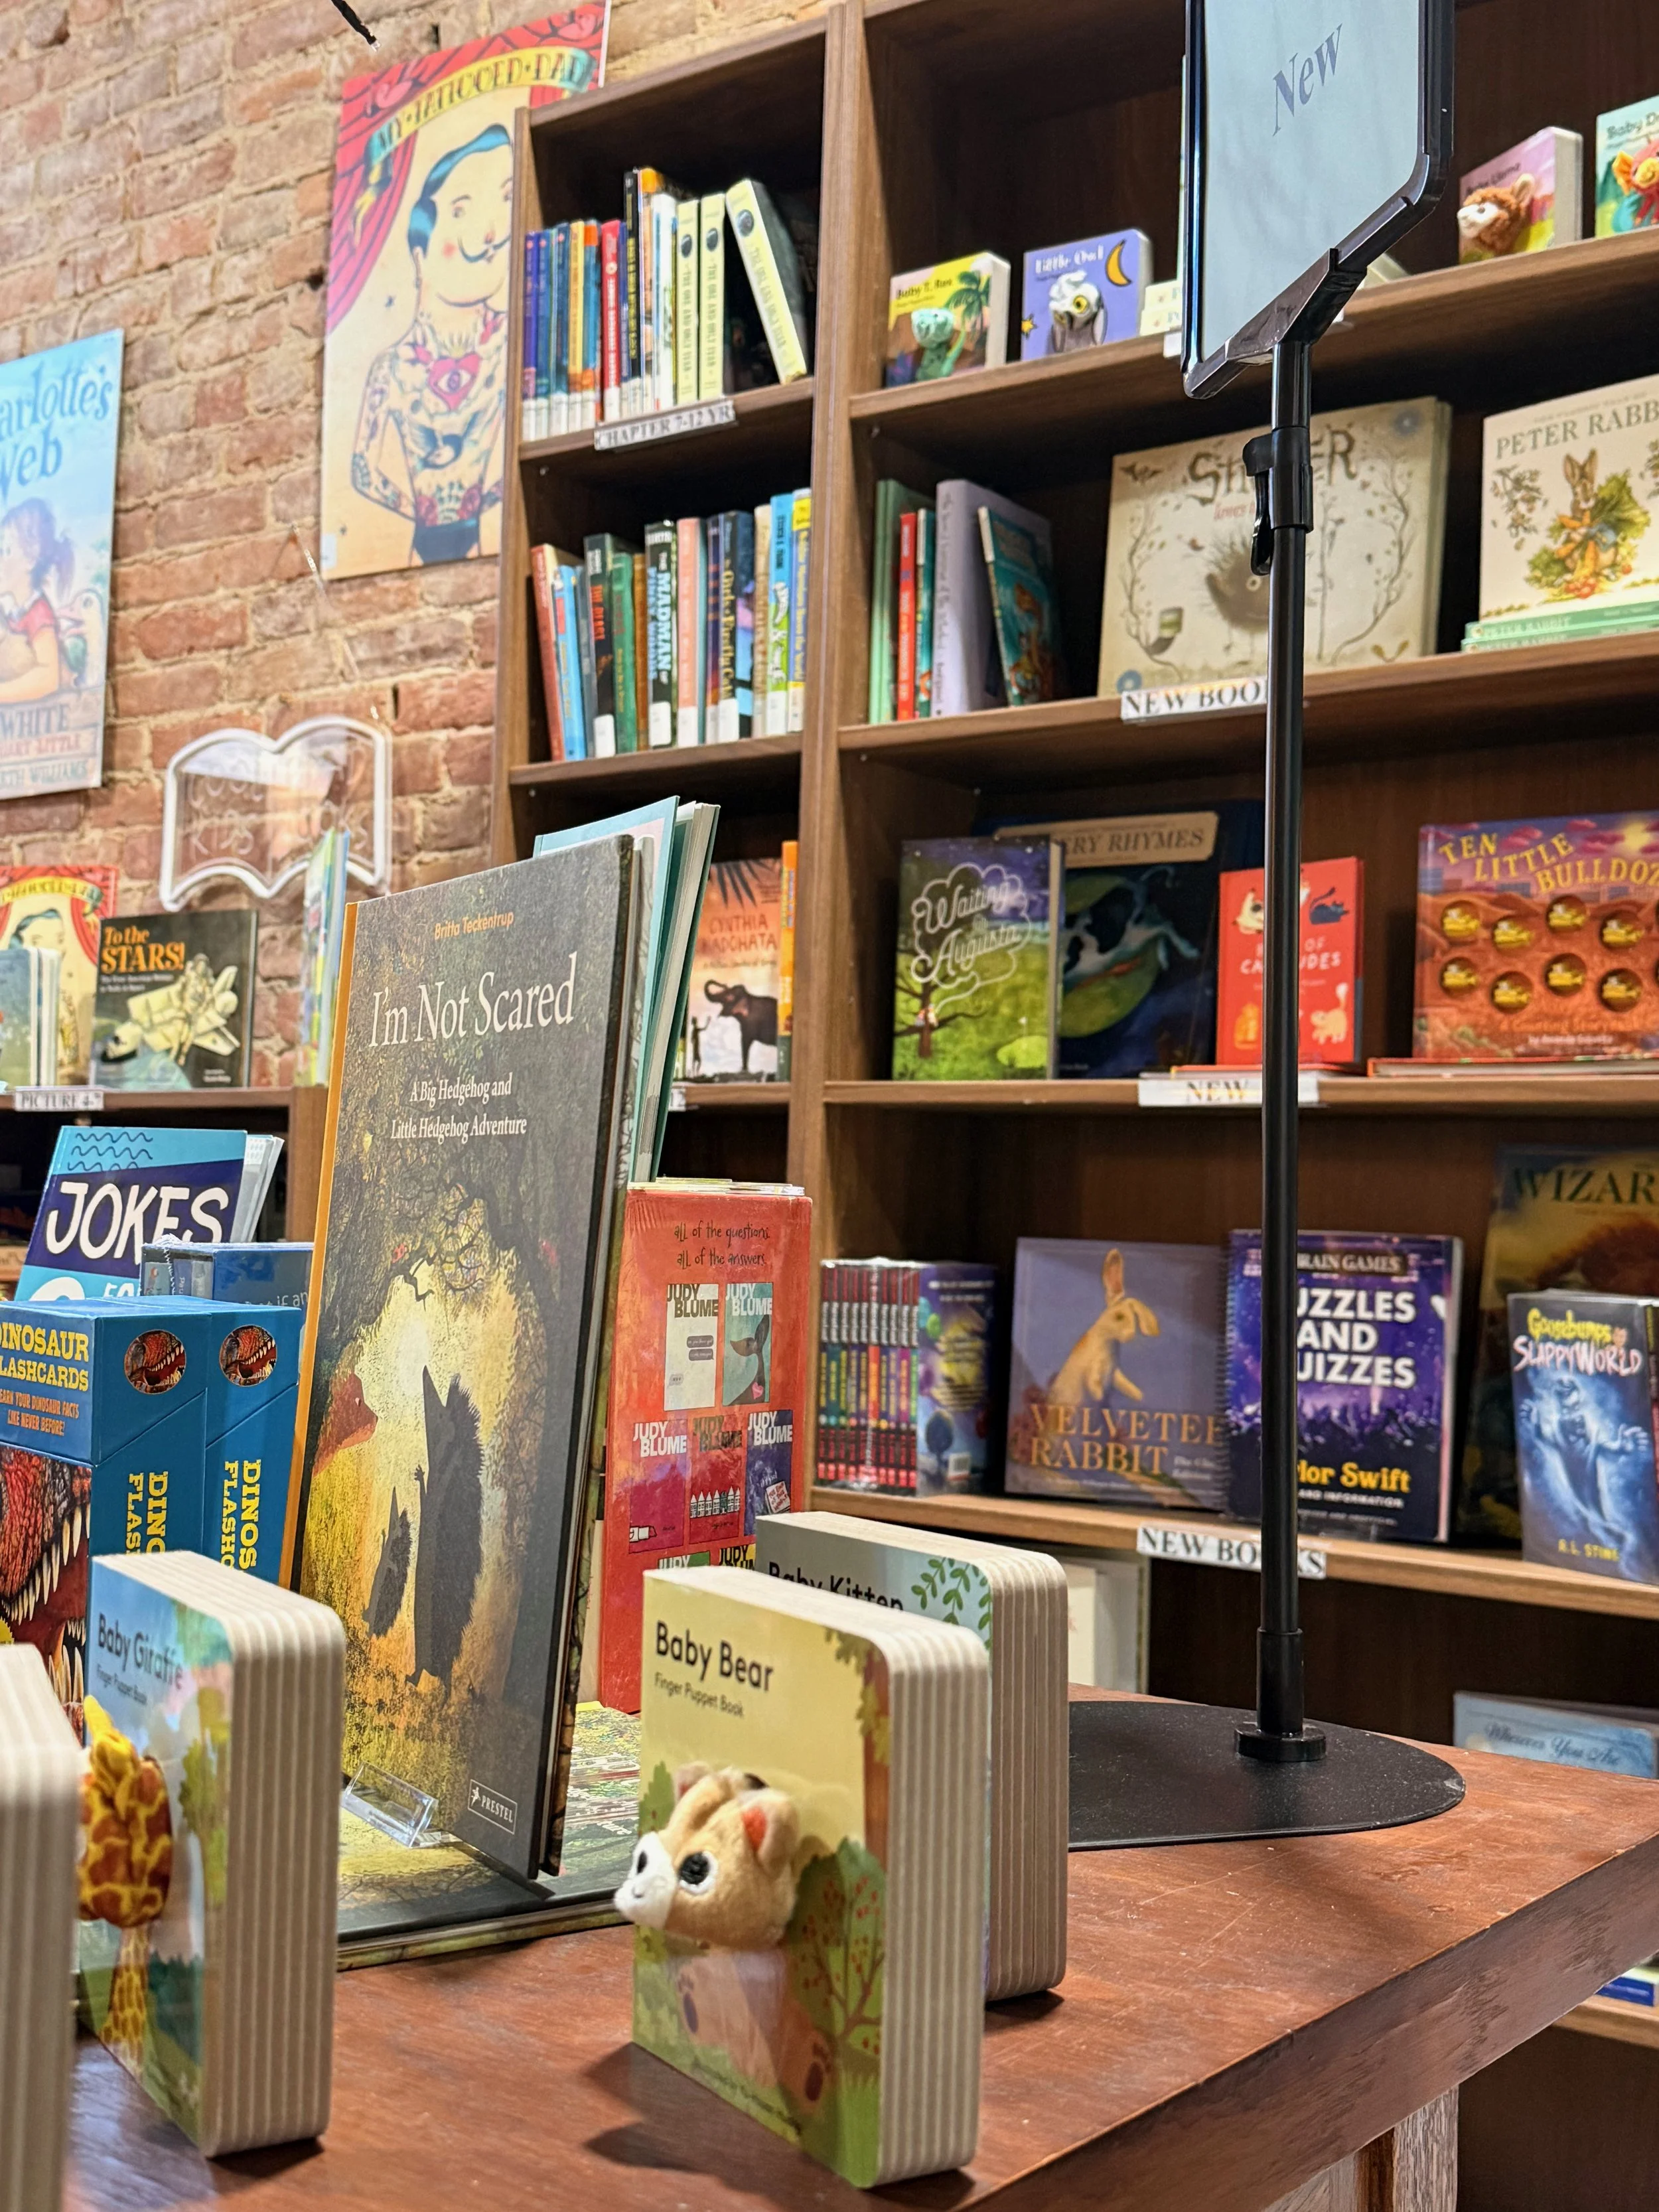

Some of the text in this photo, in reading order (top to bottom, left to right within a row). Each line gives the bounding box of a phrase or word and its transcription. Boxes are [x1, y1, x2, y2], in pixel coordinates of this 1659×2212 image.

[1272, 23, 1343, 136] New
[0, 362, 113, 438] arlotte's
[1496, 419, 1579, 460] PETER
[1588, 400, 1659, 437] RABB
[656, 573, 672, 671] MADMAN
[1127, 681, 1263, 714] NEW BOO
[1108, 829, 1204, 852] RHYMES
[1439, 833, 1499, 865] TEN
[1475, 833, 1573, 881] LITTLE
[1534, 856, 1659, 894] BULLDOZ
[709, 914, 768, 935] CYNTHIA
[911, 882, 1009, 934] Waiting
[104, 925, 149, 946] To the
[434, 910, 514, 940] Britta Teckentrup
[101, 942, 185, 974] STARS!
[911, 925, 1020, 981] Augusta
[368, 951, 577, 1049] I'm Not Scared
[19, 1093, 80, 1108] PICTURE
[409, 1072, 512, 1108] A Big Hedgehog and
[1186, 1080, 1248, 1102] NEW
[390, 1116, 527, 1144] Little Hedgehog Adventure
[1514, 1169, 1657, 1204] WIZAR
[47, 1182, 228, 1266] JOKES
[692, 1220, 702, 1238] of
[706, 1221, 721, 1238] the
[695, 1247, 705, 1265] of
[709, 1251, 725, 1266] the
[1297, 1253, 1402, 1272] RAIN GAMES
[667, 1284, 700, 1302] JUDY
[725, 1283, 756, 1300] JUDY
[732, 1297, 772, 1316] BLUME
[1297, 1288, 1416, 1323] UZZLES
[674, 1299, 719, 1318] BLUME
[0, 1321, 89, 1363] INOSAUR
[1297, 1320, 1378, 1353] AND
[1527, 1307, 1613, 1344] Goosebumps
[0, 1355, 89, 1392] LASHCARDS
[1297, 1352, 1416, 1389] UIZZES
[0, 1388, 79, 1419] EARN YOUR DINOSAUR FACTS
[7, 1409, 20, 1426] LIKE
[21, 1412, 39, 1430] NEVER
[633, 1420, 668, 1441] JUDY
[693, 1416, 723, 1436] JUDY
[748, 1411, 778, 1432] JUDY
[753, 1425, 793, 1446] BLUME
[1031, 1403, 1221, 1445] VELVETEE
[640, 1435, 687, 1457] BLUME
[699, 1430, 743, 1452] BLUME
[1031, 1437, 1168, 1474] RABBIT
[1298, 1460, 1411, 1493] lor Swift
[146, 1471, 169, 1554] DINO
[221, 1460, 238, 1569] FLASHC
[239, 1459, 261, 1569] DINOS
[1324, 1491, 1404, 1509] INFORMATION
[719, 1545, 749, 1565] JUDY
[1142, 1528, 1323, 1574] NEW BOS
[98, 1613, 183, 1690] Baby Giraffe
[656, 1620, 774, 1692] Baby Bear
[654, 1672, 745, 1718] Finger Puppet Book
[481, 1796, 514, 1823] PRESTEL
